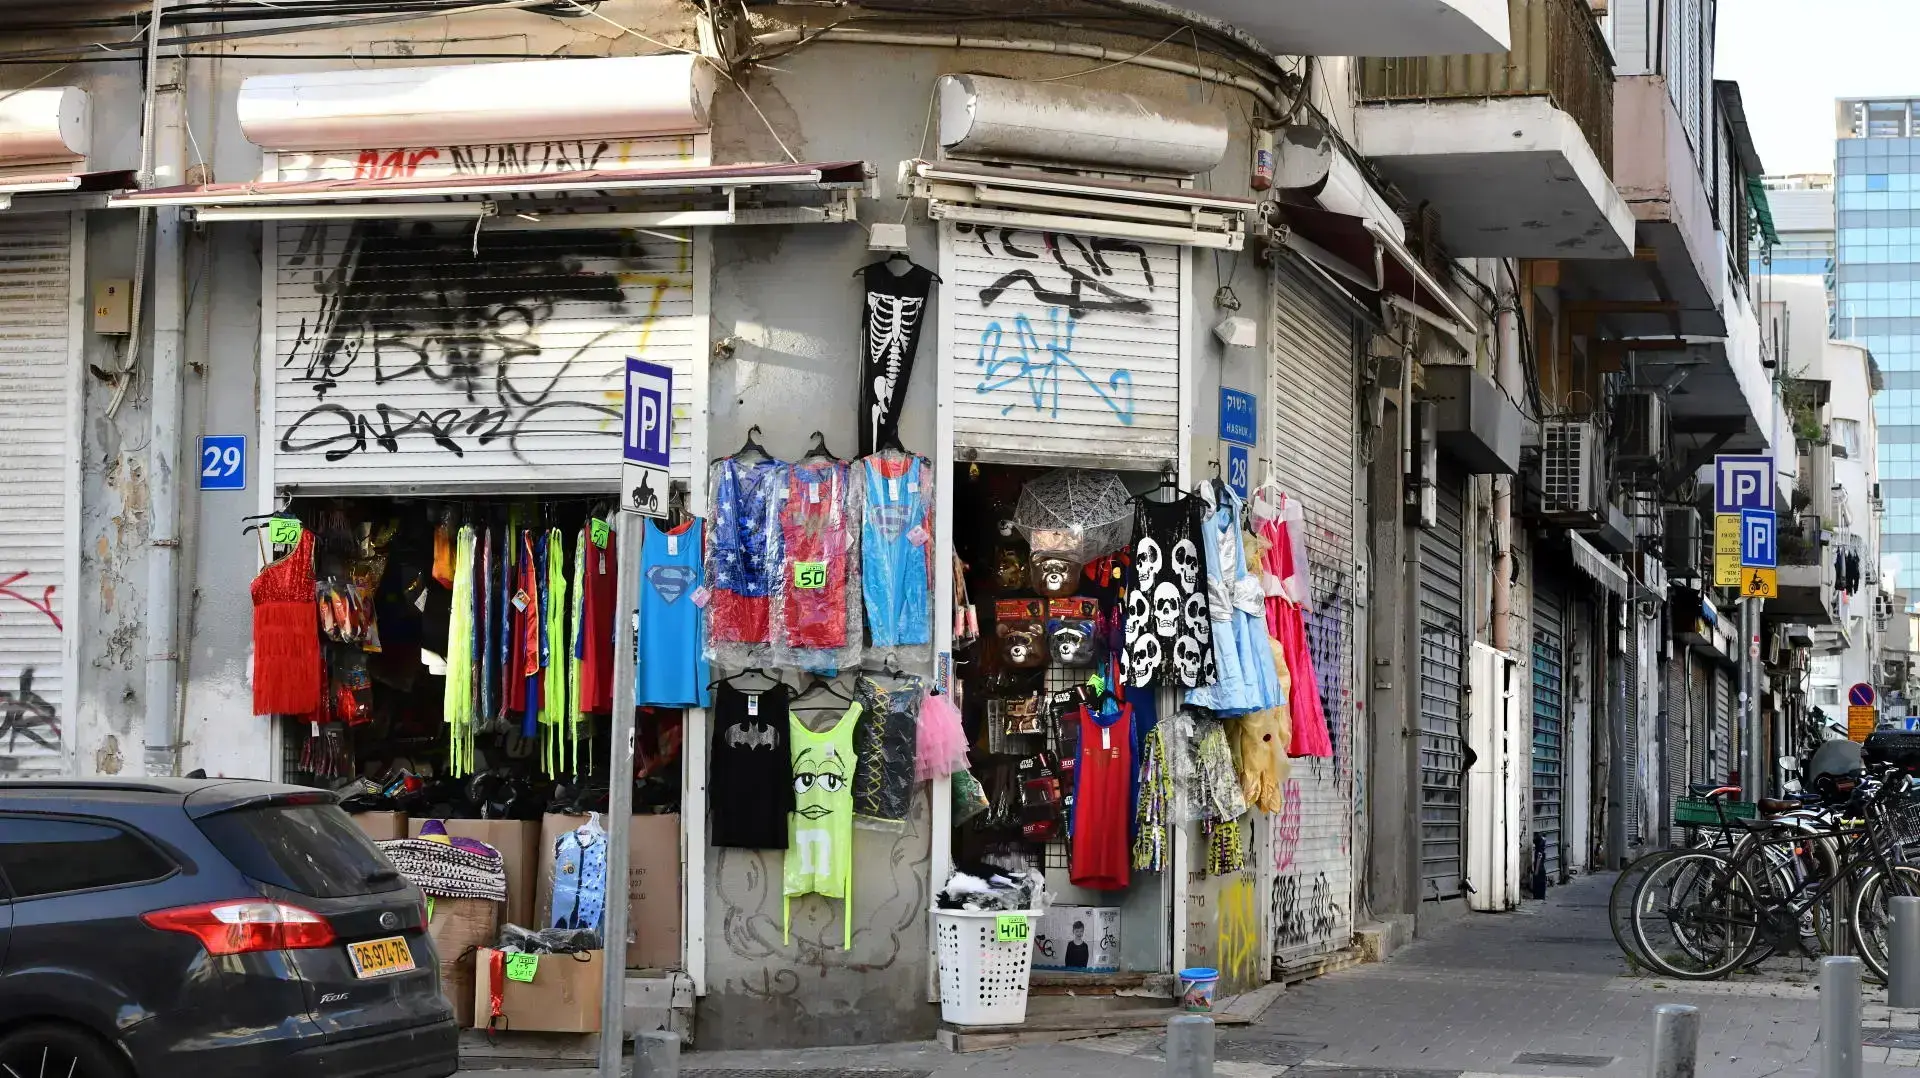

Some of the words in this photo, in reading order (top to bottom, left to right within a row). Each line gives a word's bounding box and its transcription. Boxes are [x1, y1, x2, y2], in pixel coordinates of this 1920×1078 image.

[1226, 422, 1248, 437] HASHUK
[203, 445, 241, 477] 29
[1231, 457, 1247, 488] 28
[275, 527, 297, 543] 50
[801, 571, 824, 586] 50
